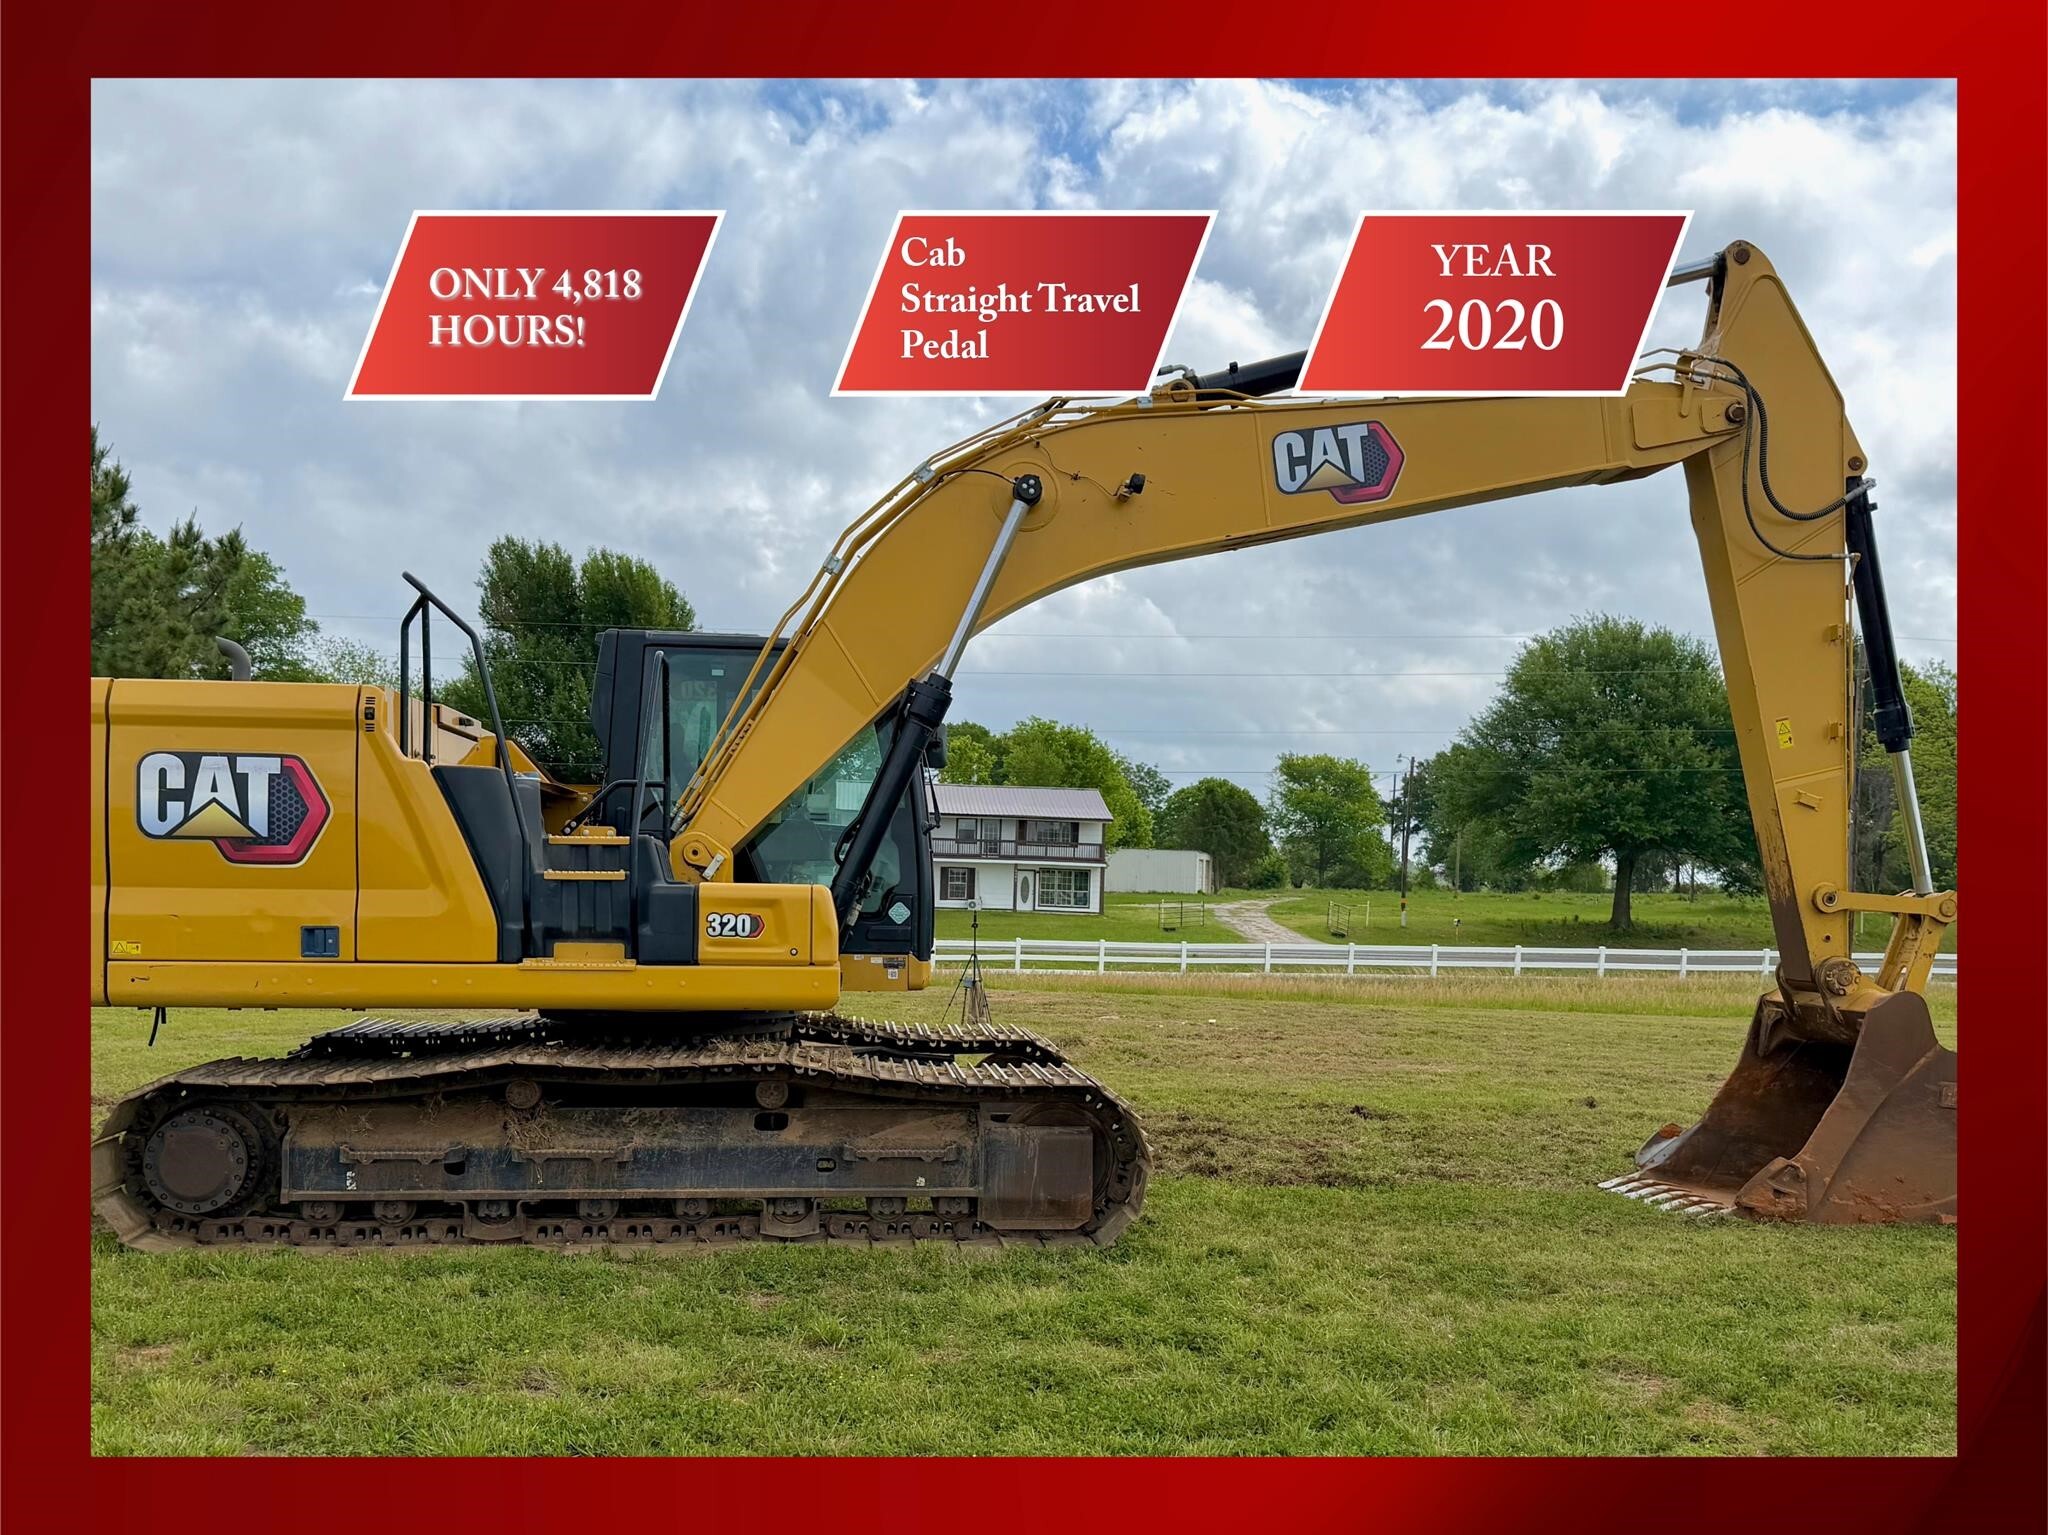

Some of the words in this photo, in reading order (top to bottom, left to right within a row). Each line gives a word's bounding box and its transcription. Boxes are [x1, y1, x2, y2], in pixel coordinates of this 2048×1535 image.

[1273, 423, 1369, 492] CAT
[140, 752, 282, 838] CAT
[706, 912, 751, 937] 320
